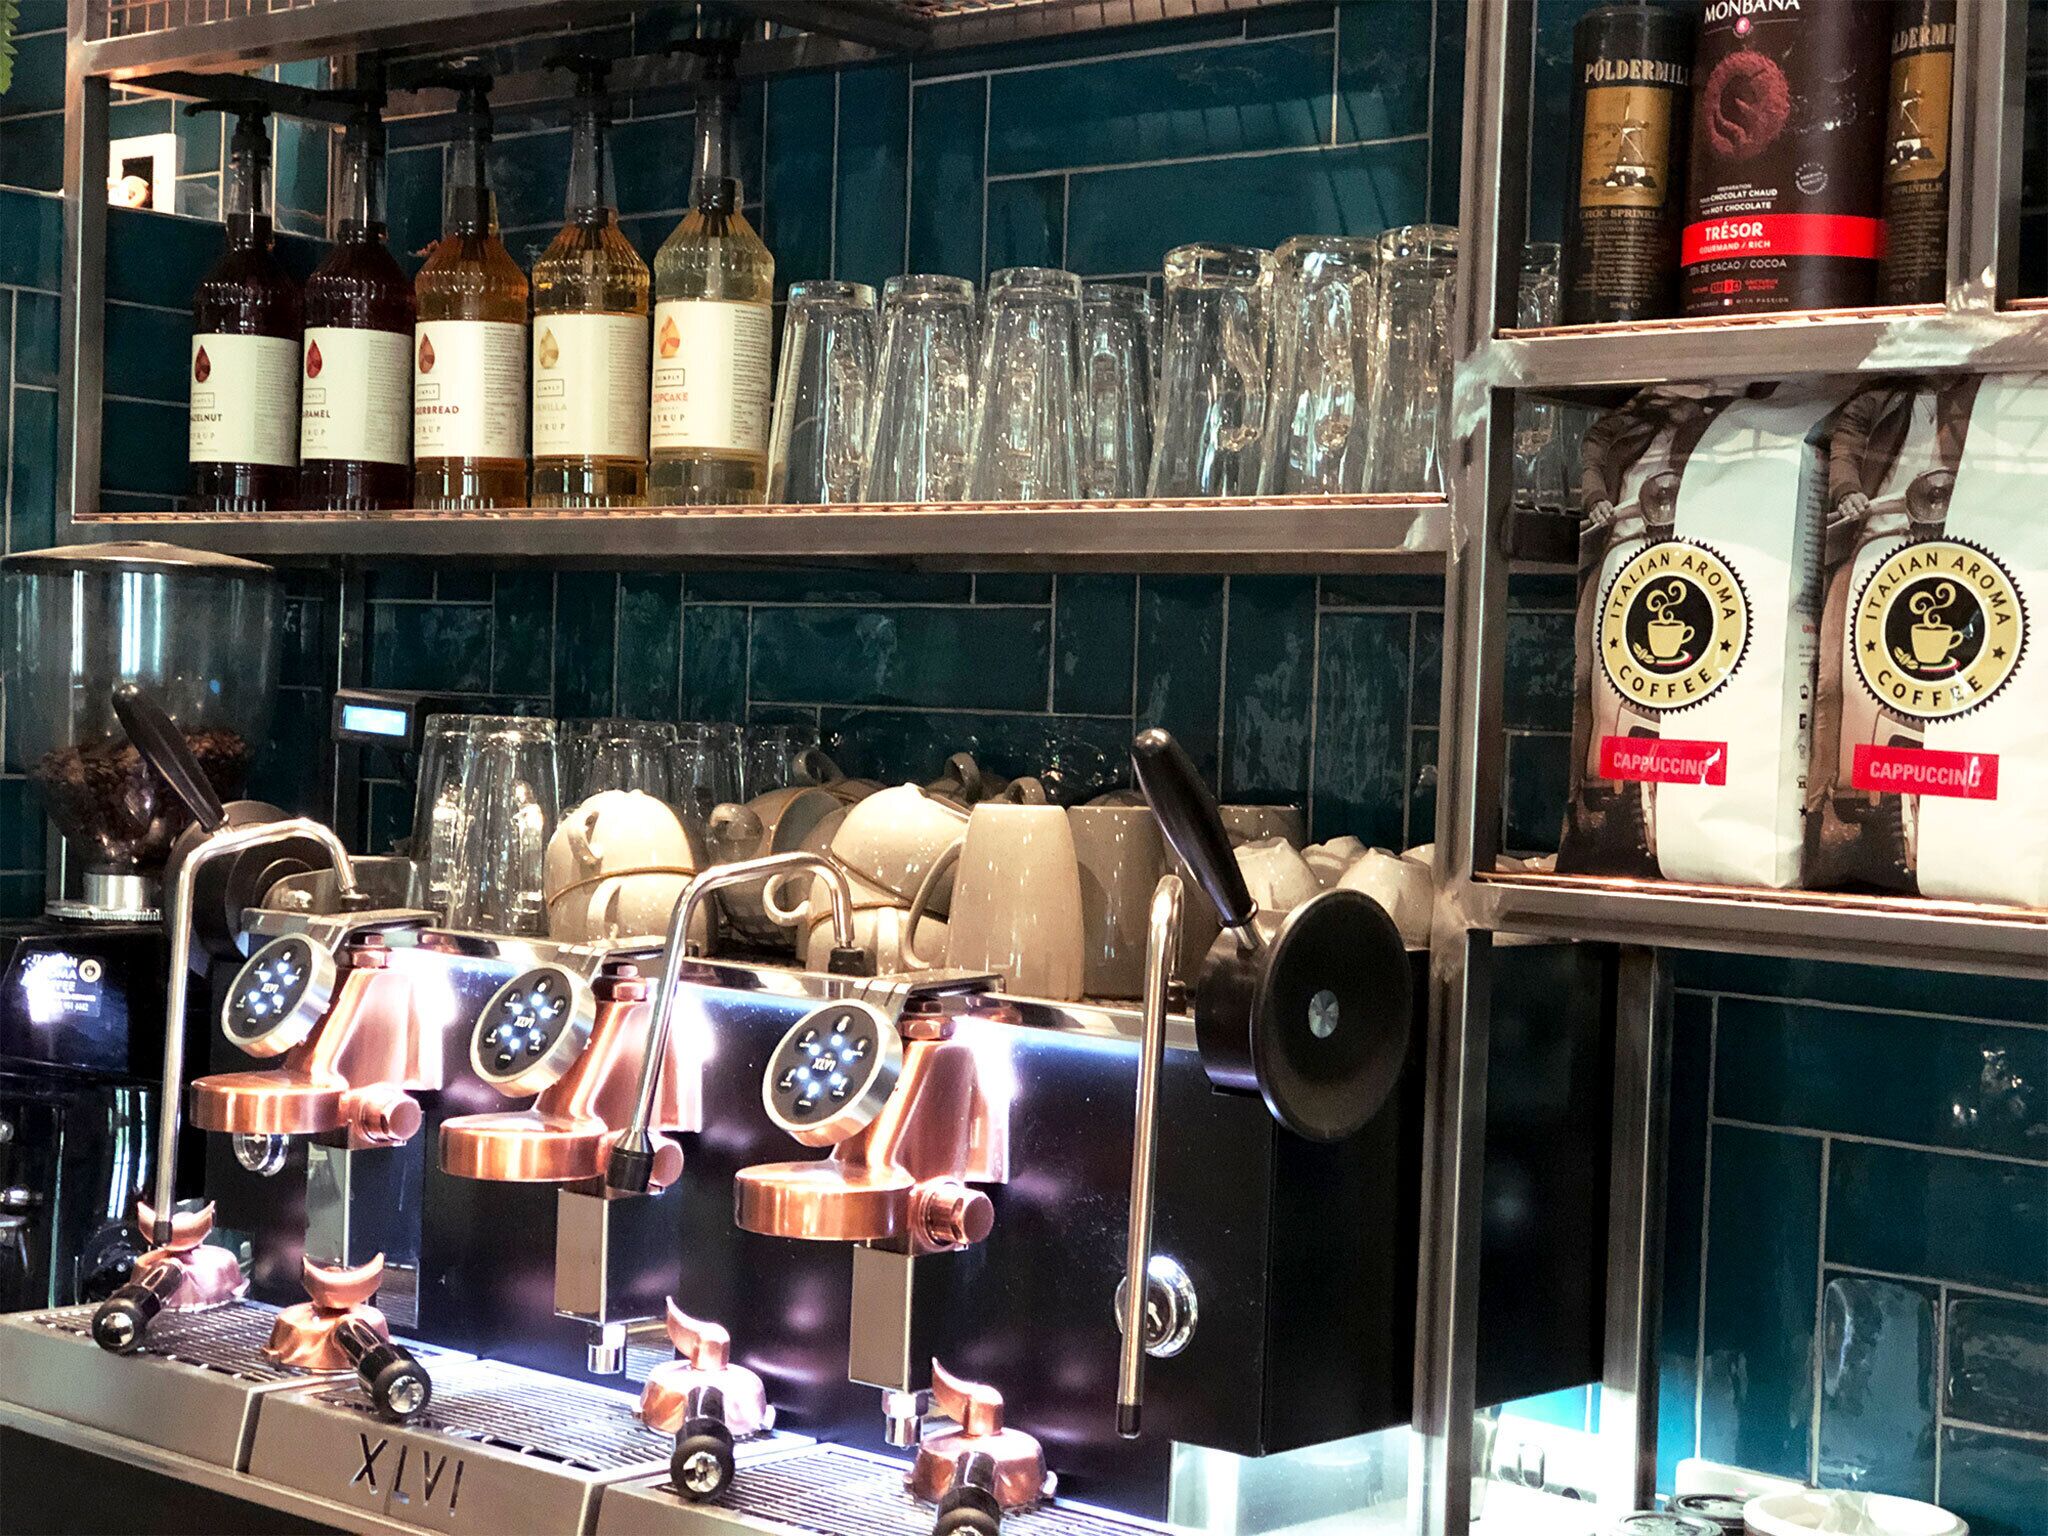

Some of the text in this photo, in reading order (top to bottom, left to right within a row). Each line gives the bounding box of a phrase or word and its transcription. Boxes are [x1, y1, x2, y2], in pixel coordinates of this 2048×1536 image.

[1704, 0, 1800, 23] MONBANA
[1710, 190, 1747, 203] CHOCOLAT
[1748, 188, 1778, 198] CHAUD
[1724, 201, 1772, 212] CHOCOLATE
[1705, 221, 1764, 241] TRÉSOR
[1748, 240, 1771, 249] RICH
[1711, 261, 1740, 272] CACAO
[1749, 258, 1787, 268] COCOA
[1610, 552, 1736, 620] ITALIAN AROMA
[1866, 552, 2011, 625] ITALIAN AROMA
[1620, 665, 1711, 698] COFFEE
[1613, 752, 1709, 776] CAPPUCCINO
[349, 1432, 465, 1518] XLVI
